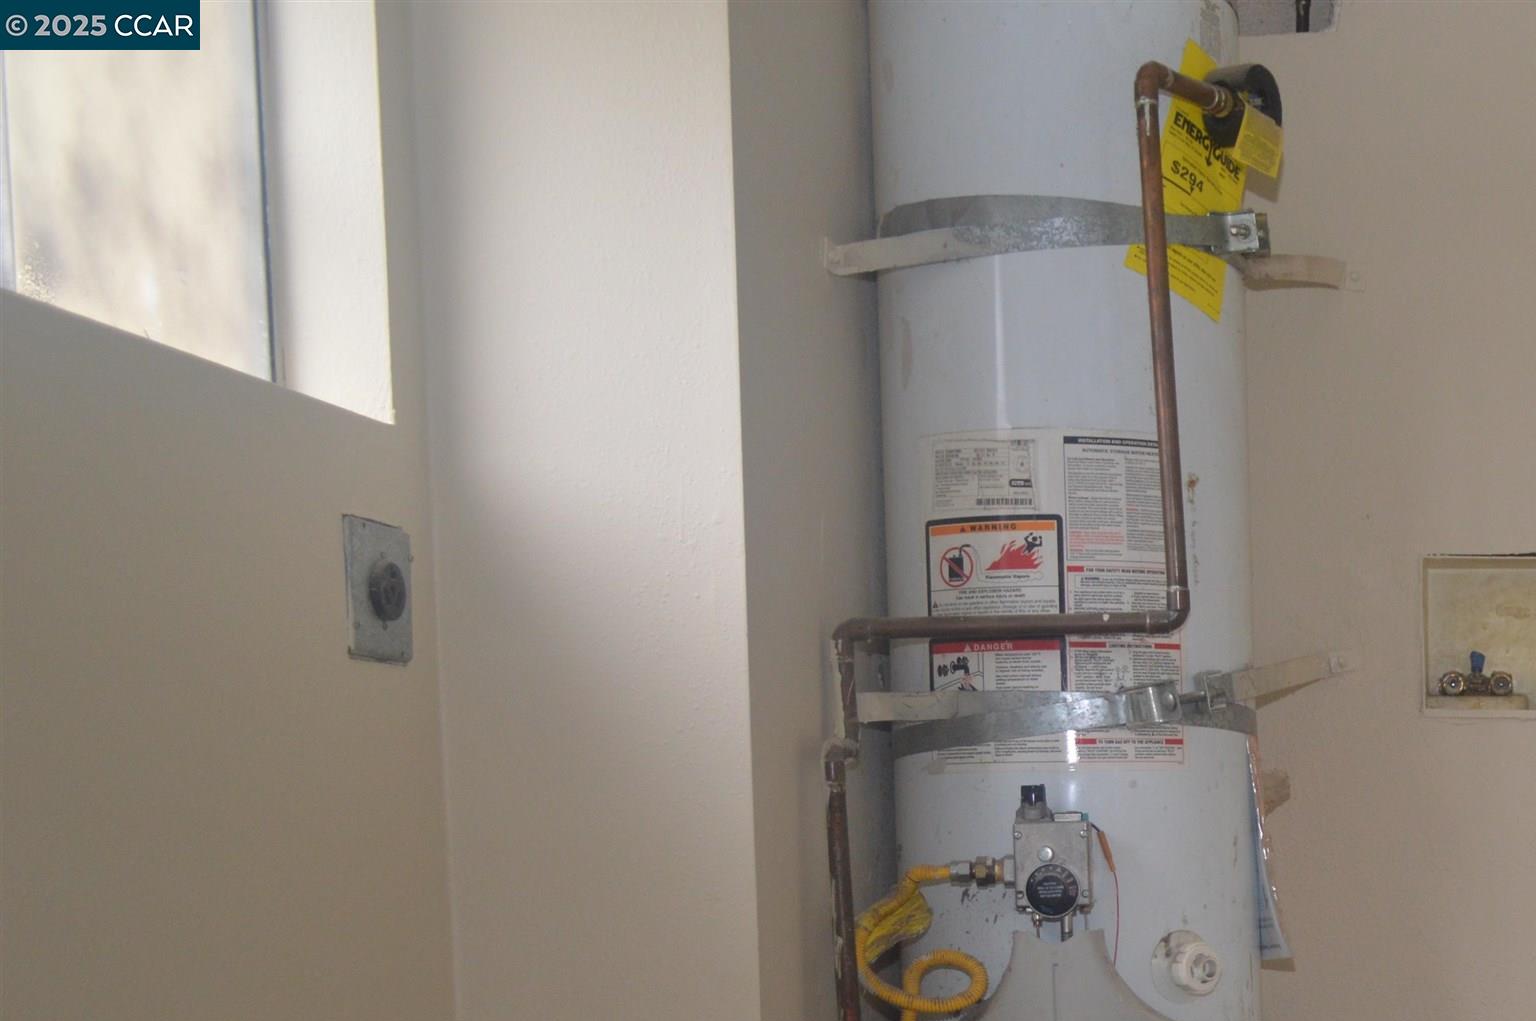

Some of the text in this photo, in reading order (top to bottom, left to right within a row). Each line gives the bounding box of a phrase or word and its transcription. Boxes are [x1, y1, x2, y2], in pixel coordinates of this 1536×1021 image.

[1170, 160, 1204, 193] $294
[969, 522, 1017, 532] WARNING
[973, 642, 1014, 651] DANGER
